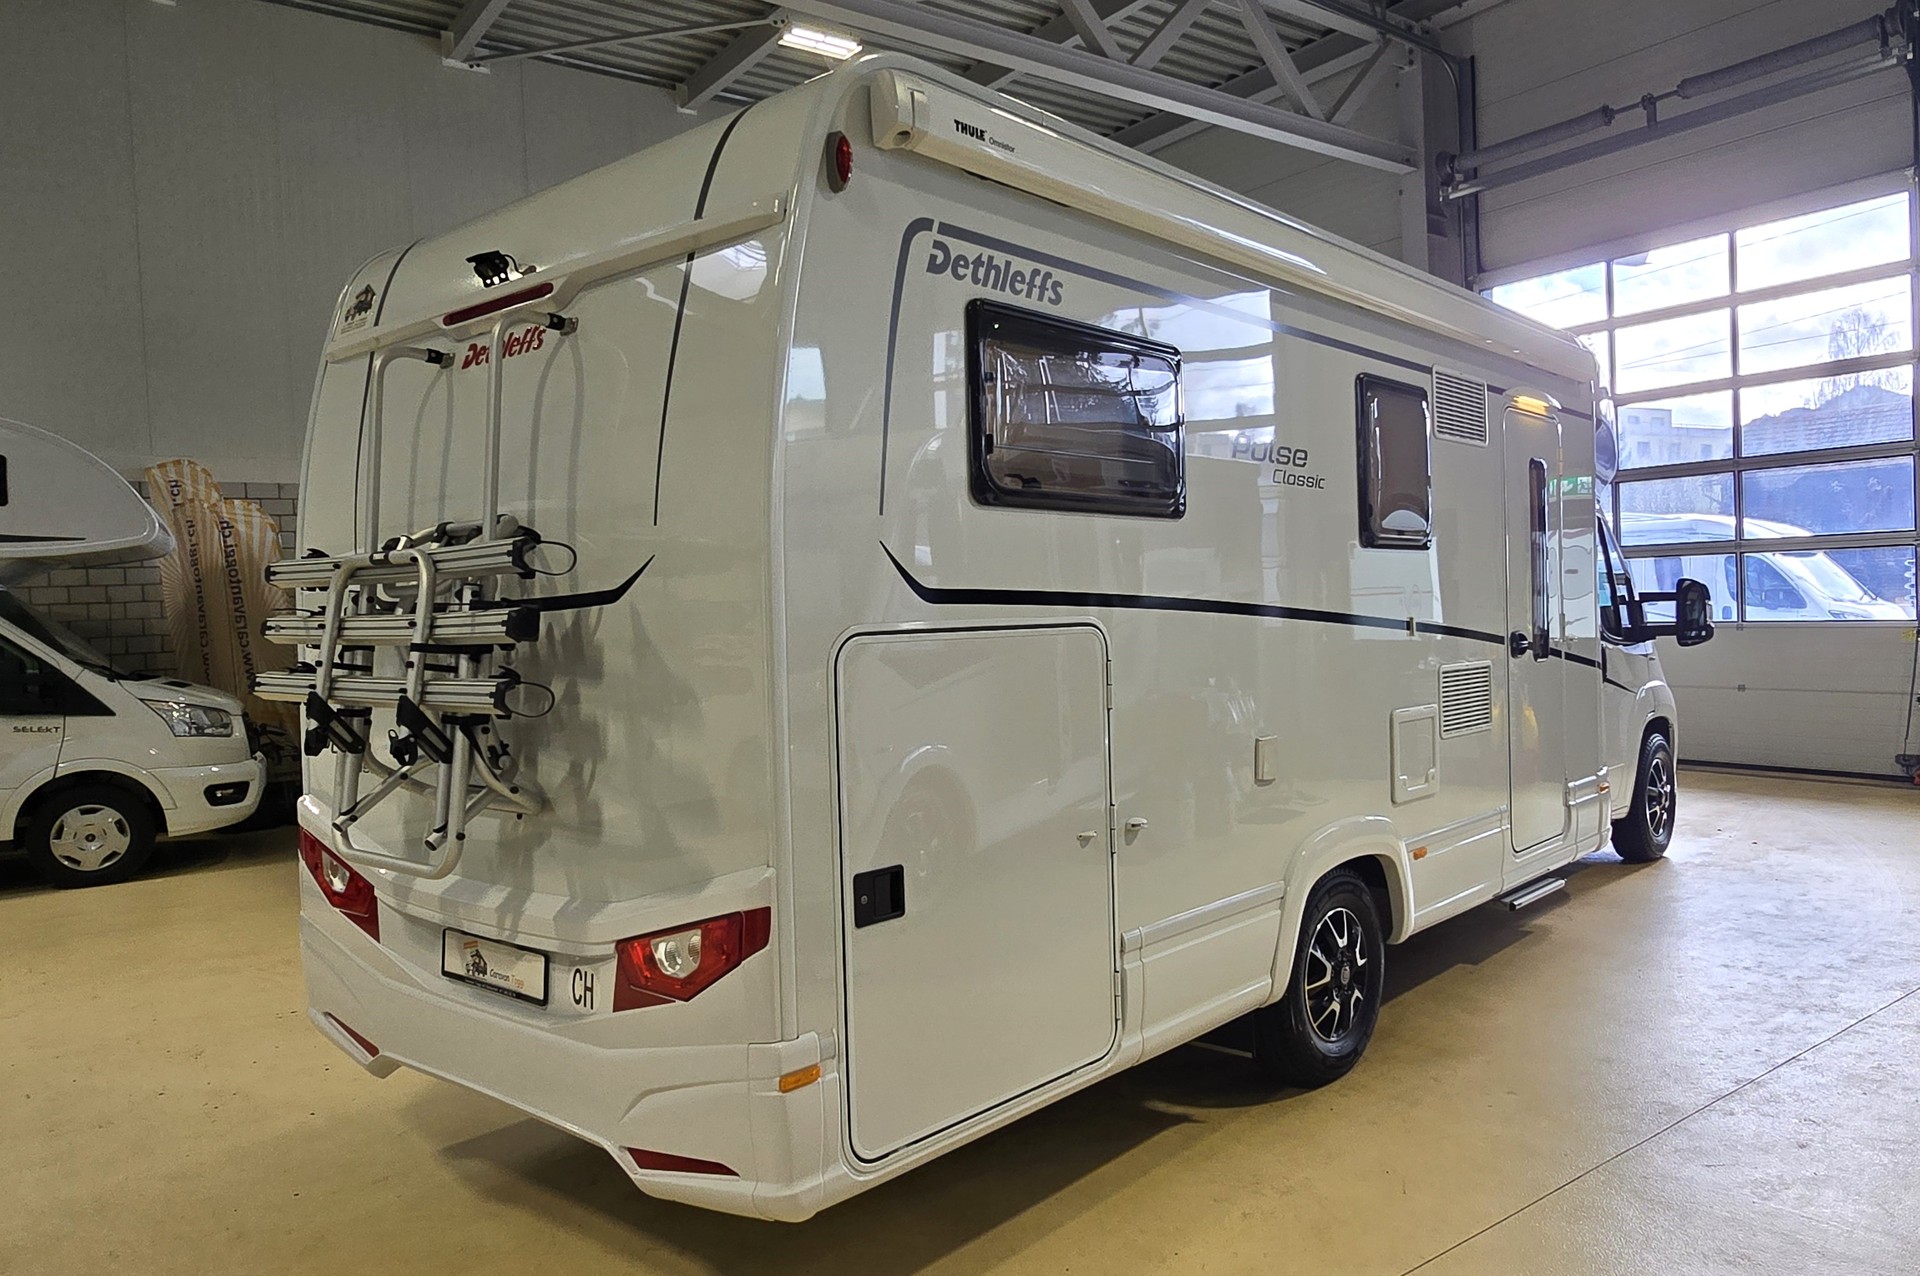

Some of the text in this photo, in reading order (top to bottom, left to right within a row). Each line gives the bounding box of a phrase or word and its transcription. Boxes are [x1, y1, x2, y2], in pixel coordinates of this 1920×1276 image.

[953, 118, 987, 142] THULE
[926, 239, 1064, 306] Dethleffs
[461, 325, 547, 370] Detleffs
[1231, 432, 1308, 468] Pulse
[1272, 468, 1325, 489] Classic
[572, 967, 594, 1009] CH
